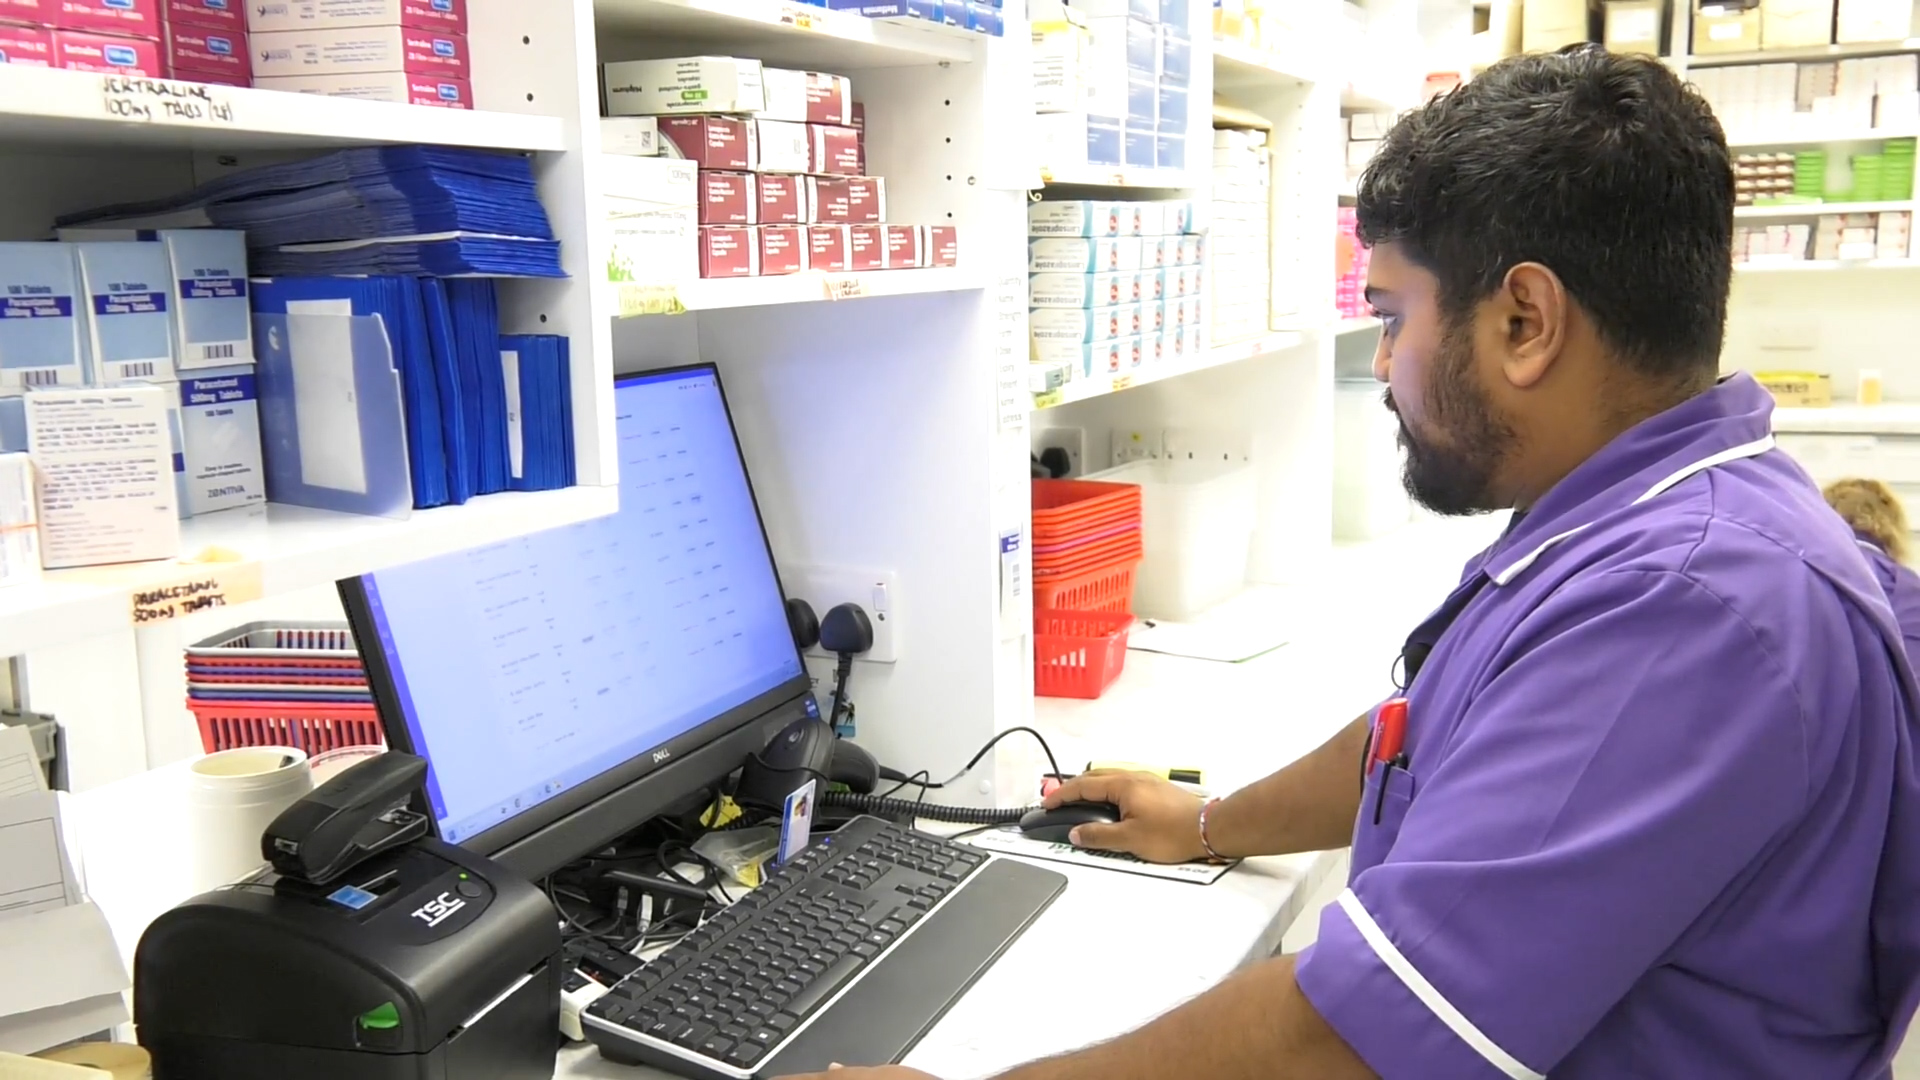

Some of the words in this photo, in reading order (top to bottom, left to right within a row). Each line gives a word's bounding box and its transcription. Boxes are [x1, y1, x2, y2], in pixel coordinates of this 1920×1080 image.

[162, 100, 202, 119] TABS
[652, 747, 671, 764] DELL
[410, 890, 461, 922] TSC
